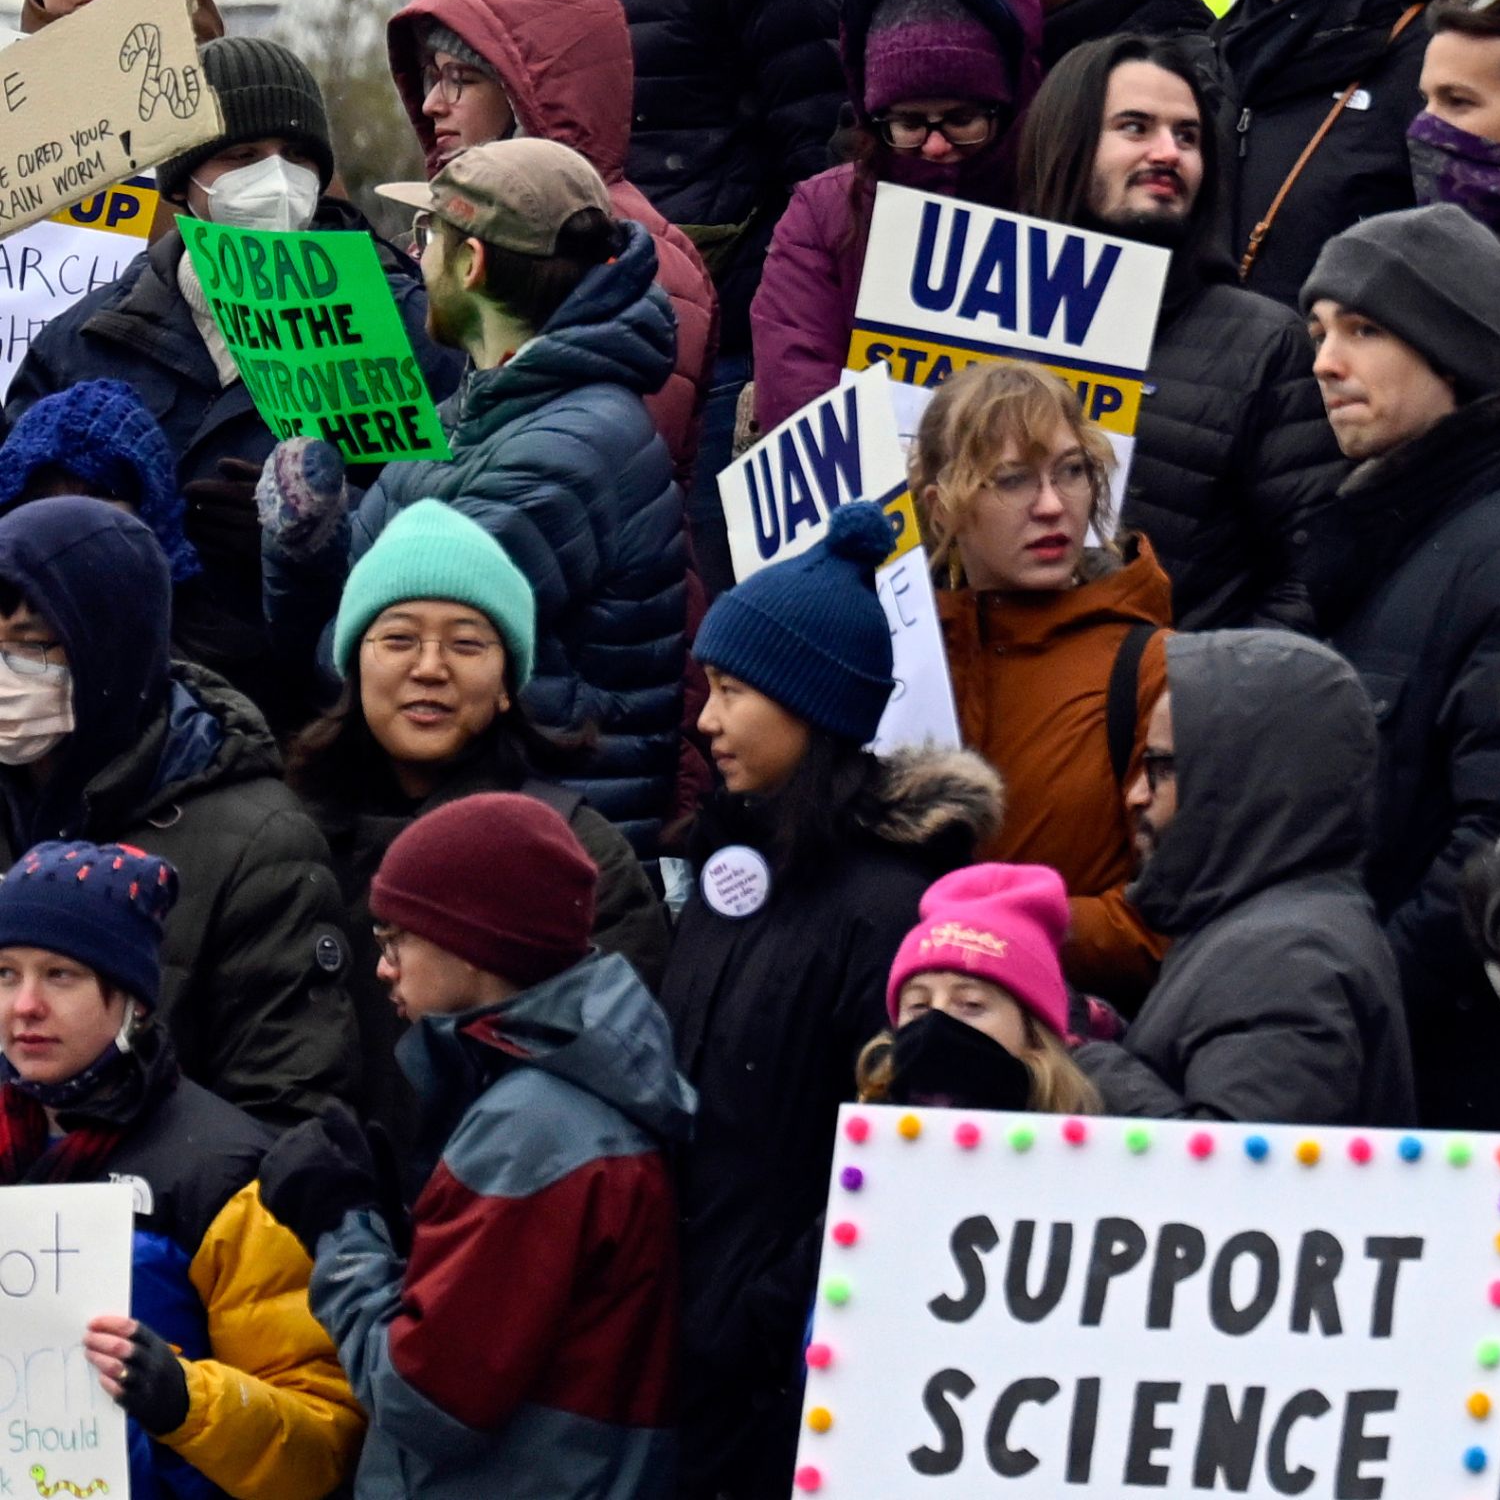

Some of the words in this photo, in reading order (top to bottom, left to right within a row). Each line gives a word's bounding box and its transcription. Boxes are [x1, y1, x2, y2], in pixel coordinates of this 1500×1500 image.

[17, 141, 64, 179] CURED
[70, 119, 114, 157] YOUR
[52, 151, 106, 195] WORM
[70, 190, 140, 228] UP
[909, 201, 1122, 347] UAW
[316, 405, 432, 456] HERE
[742, 386, 863, 561] UAW
[926, 1213, 1425, 1338] SUPPORT
[8, 1418, 99, 1453] Should
[907, 1366, 1400, 1500] SCIENCE
